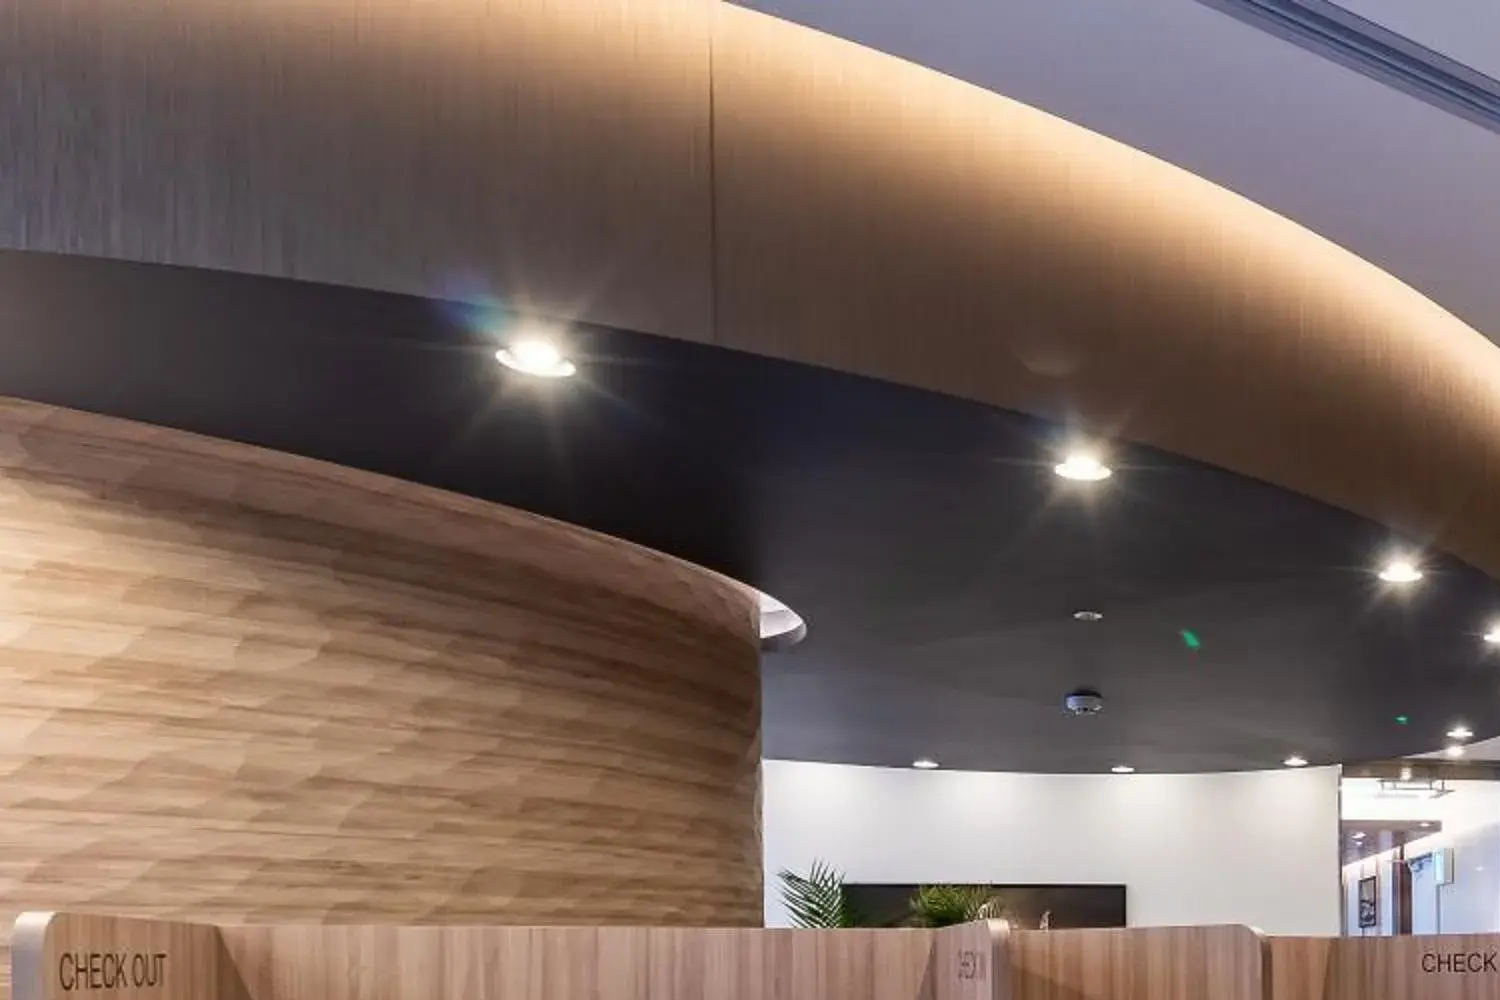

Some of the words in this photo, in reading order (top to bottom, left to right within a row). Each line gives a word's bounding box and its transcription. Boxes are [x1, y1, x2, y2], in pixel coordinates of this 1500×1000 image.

[59, 953, 127, 991] CHECK
[132, 953, 167, 987] OUT
[1421, 953, 1497, 973] CHECK
